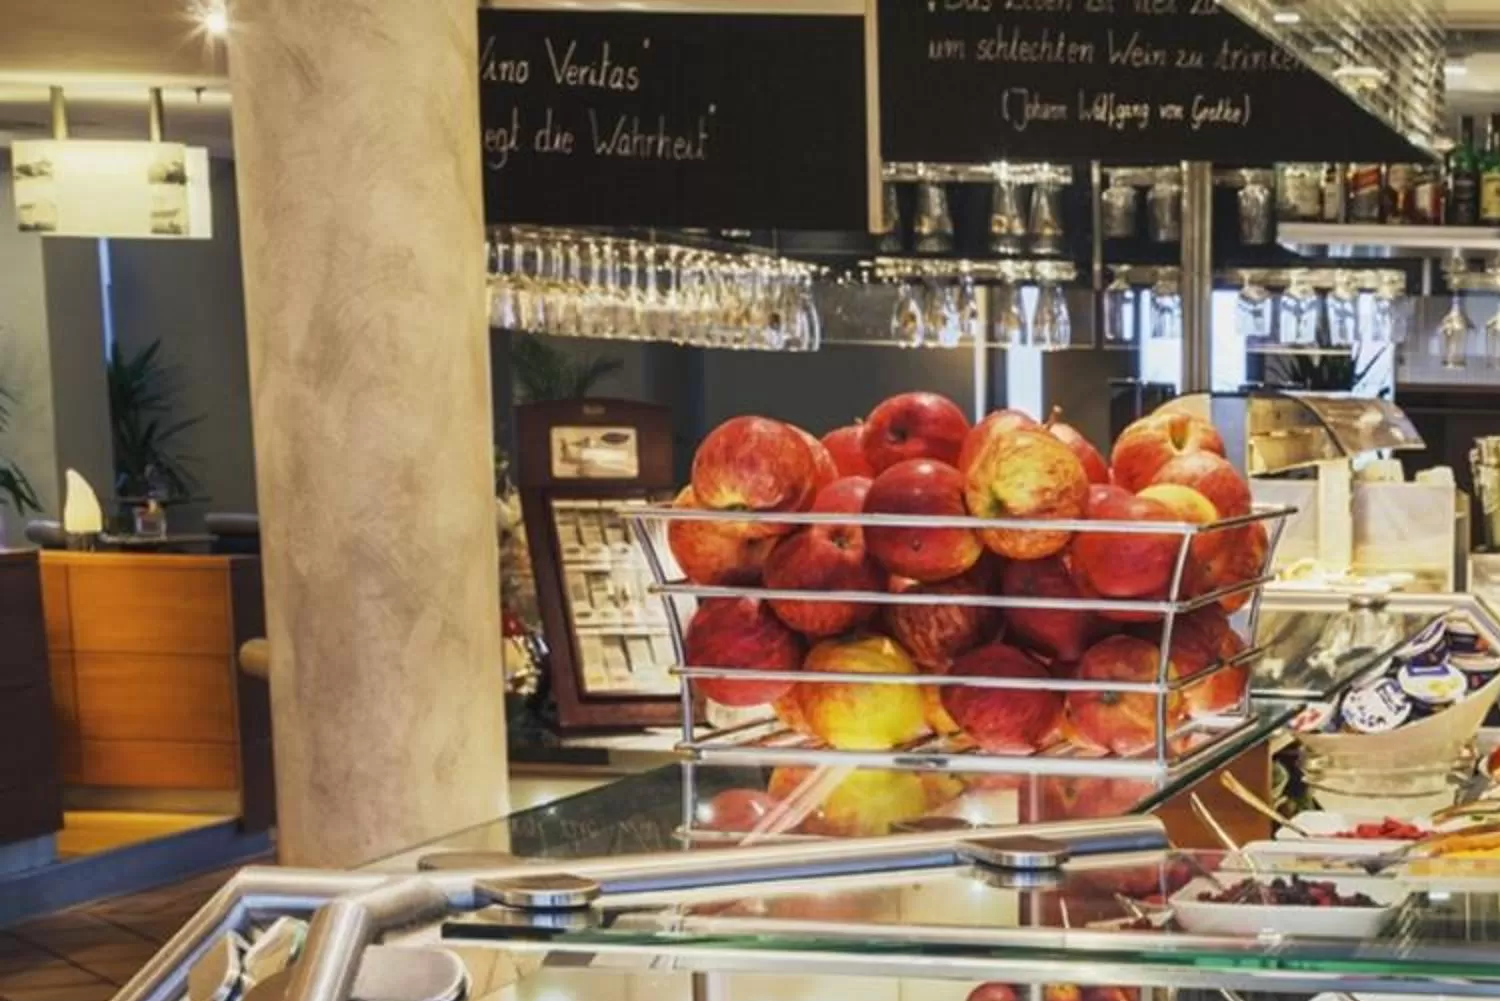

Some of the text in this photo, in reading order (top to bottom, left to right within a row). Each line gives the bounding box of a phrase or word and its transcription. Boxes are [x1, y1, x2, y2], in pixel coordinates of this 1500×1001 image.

[927, 39, 966, 61] um
[976, 24, 1094, 64] schlechten
[1107, 28, 1166, 67] Wein
[1175, 48, 1204, 68] zu
[534, 107, 576, 155] die
[1159, 102, 1184, 120] von
